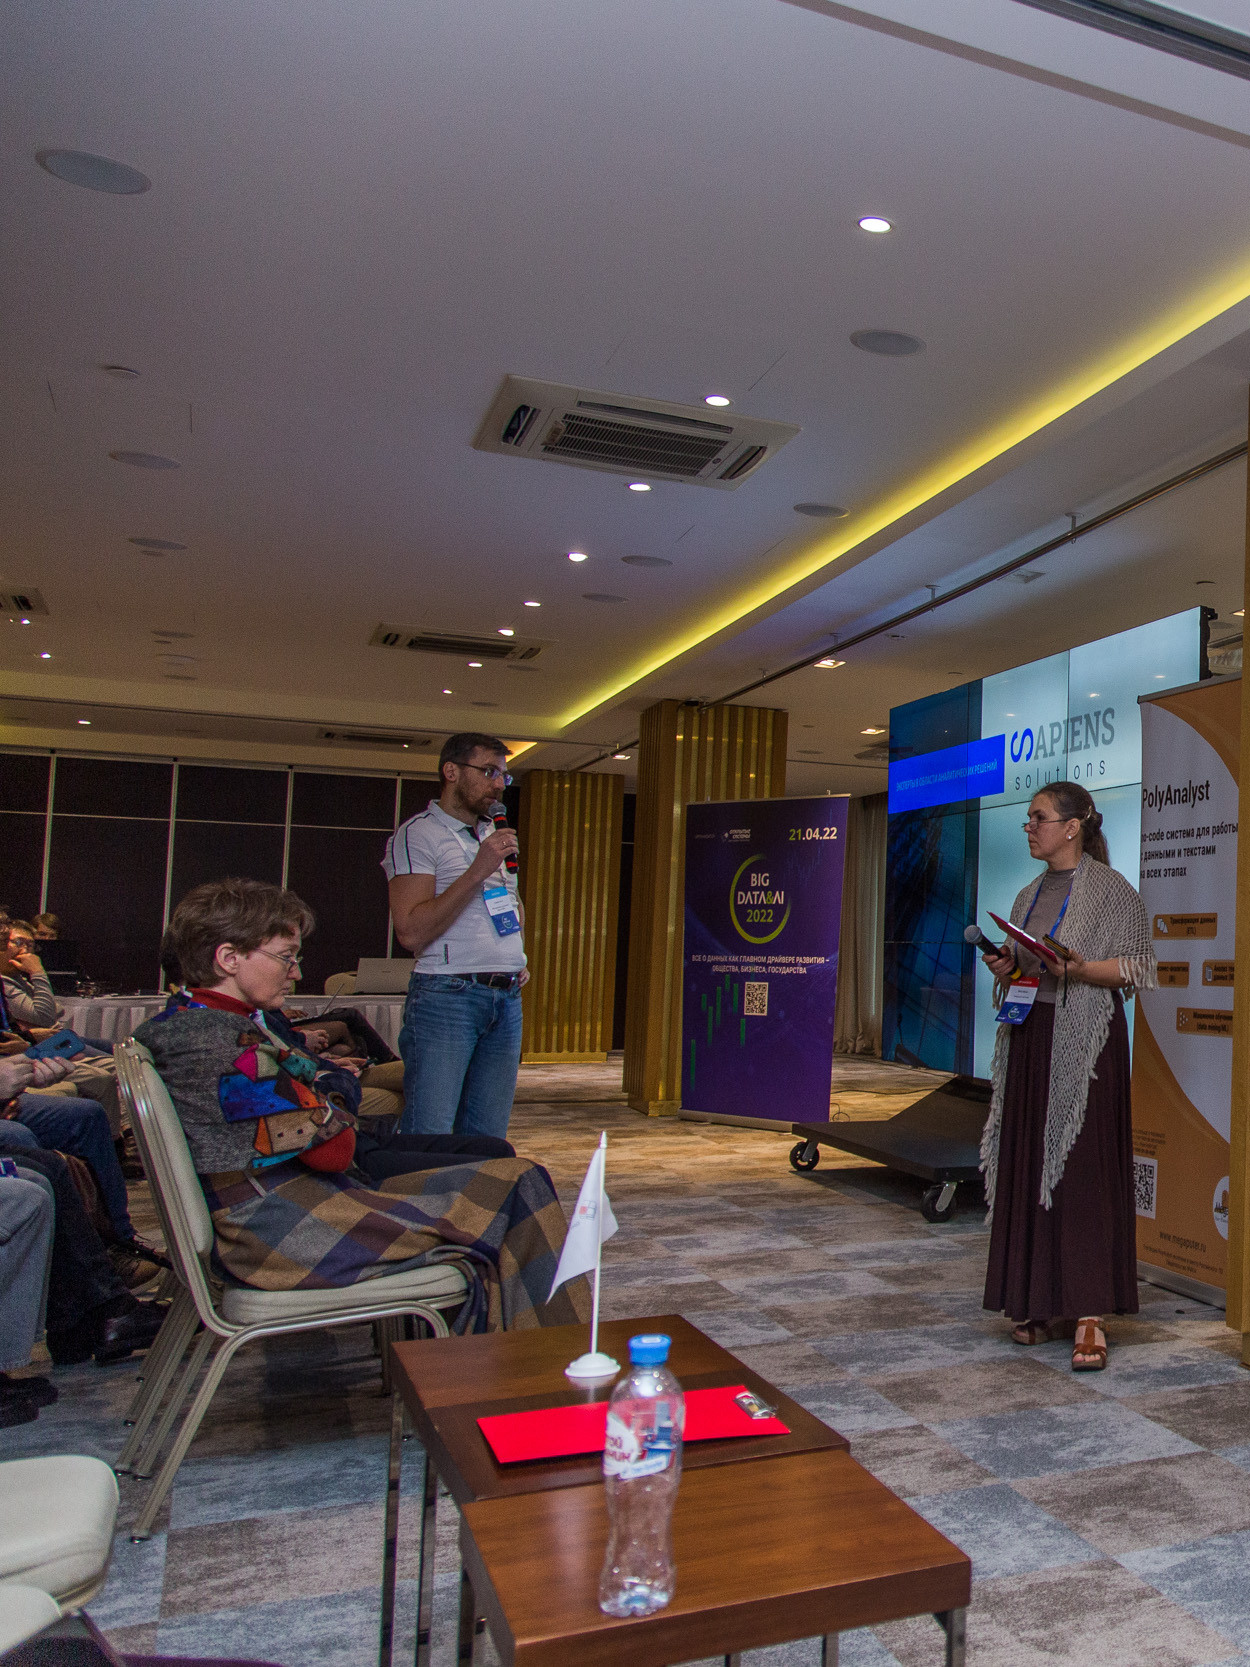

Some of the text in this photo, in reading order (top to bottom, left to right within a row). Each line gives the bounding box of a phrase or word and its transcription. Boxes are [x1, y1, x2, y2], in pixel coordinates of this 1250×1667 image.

[1010, 707, 1115, 763] SAPIENS
[1015, 760, 1106, 791] solutons
[1142, 780, 1210, 812] PolyAnalyst
[789, 827, 838, 840] 21.04.22
[1166, 828, 1194, 840] система
[1196, 826, 1210, 839] для
[1144, 849, 1175, 863] данными
[1177, 848, 1182, 858] и
[1183, 845, 1216, 857] текстами
[1147, 867, 1161, 878] всех
[1163, 866, 1187, 877] этапах
[751, 873, 769, 886] BIG
[746, 909, 773, 922] 2022
[740, 955, 766, 963] ГЛАВНОМ
[767, 955, 795, 964] ДРАЙВЕРЕ
[796, 956, 825, 964] РАЗВИТИЯ
[768, 966, 807, 974] ГОСУДАРСТВА
